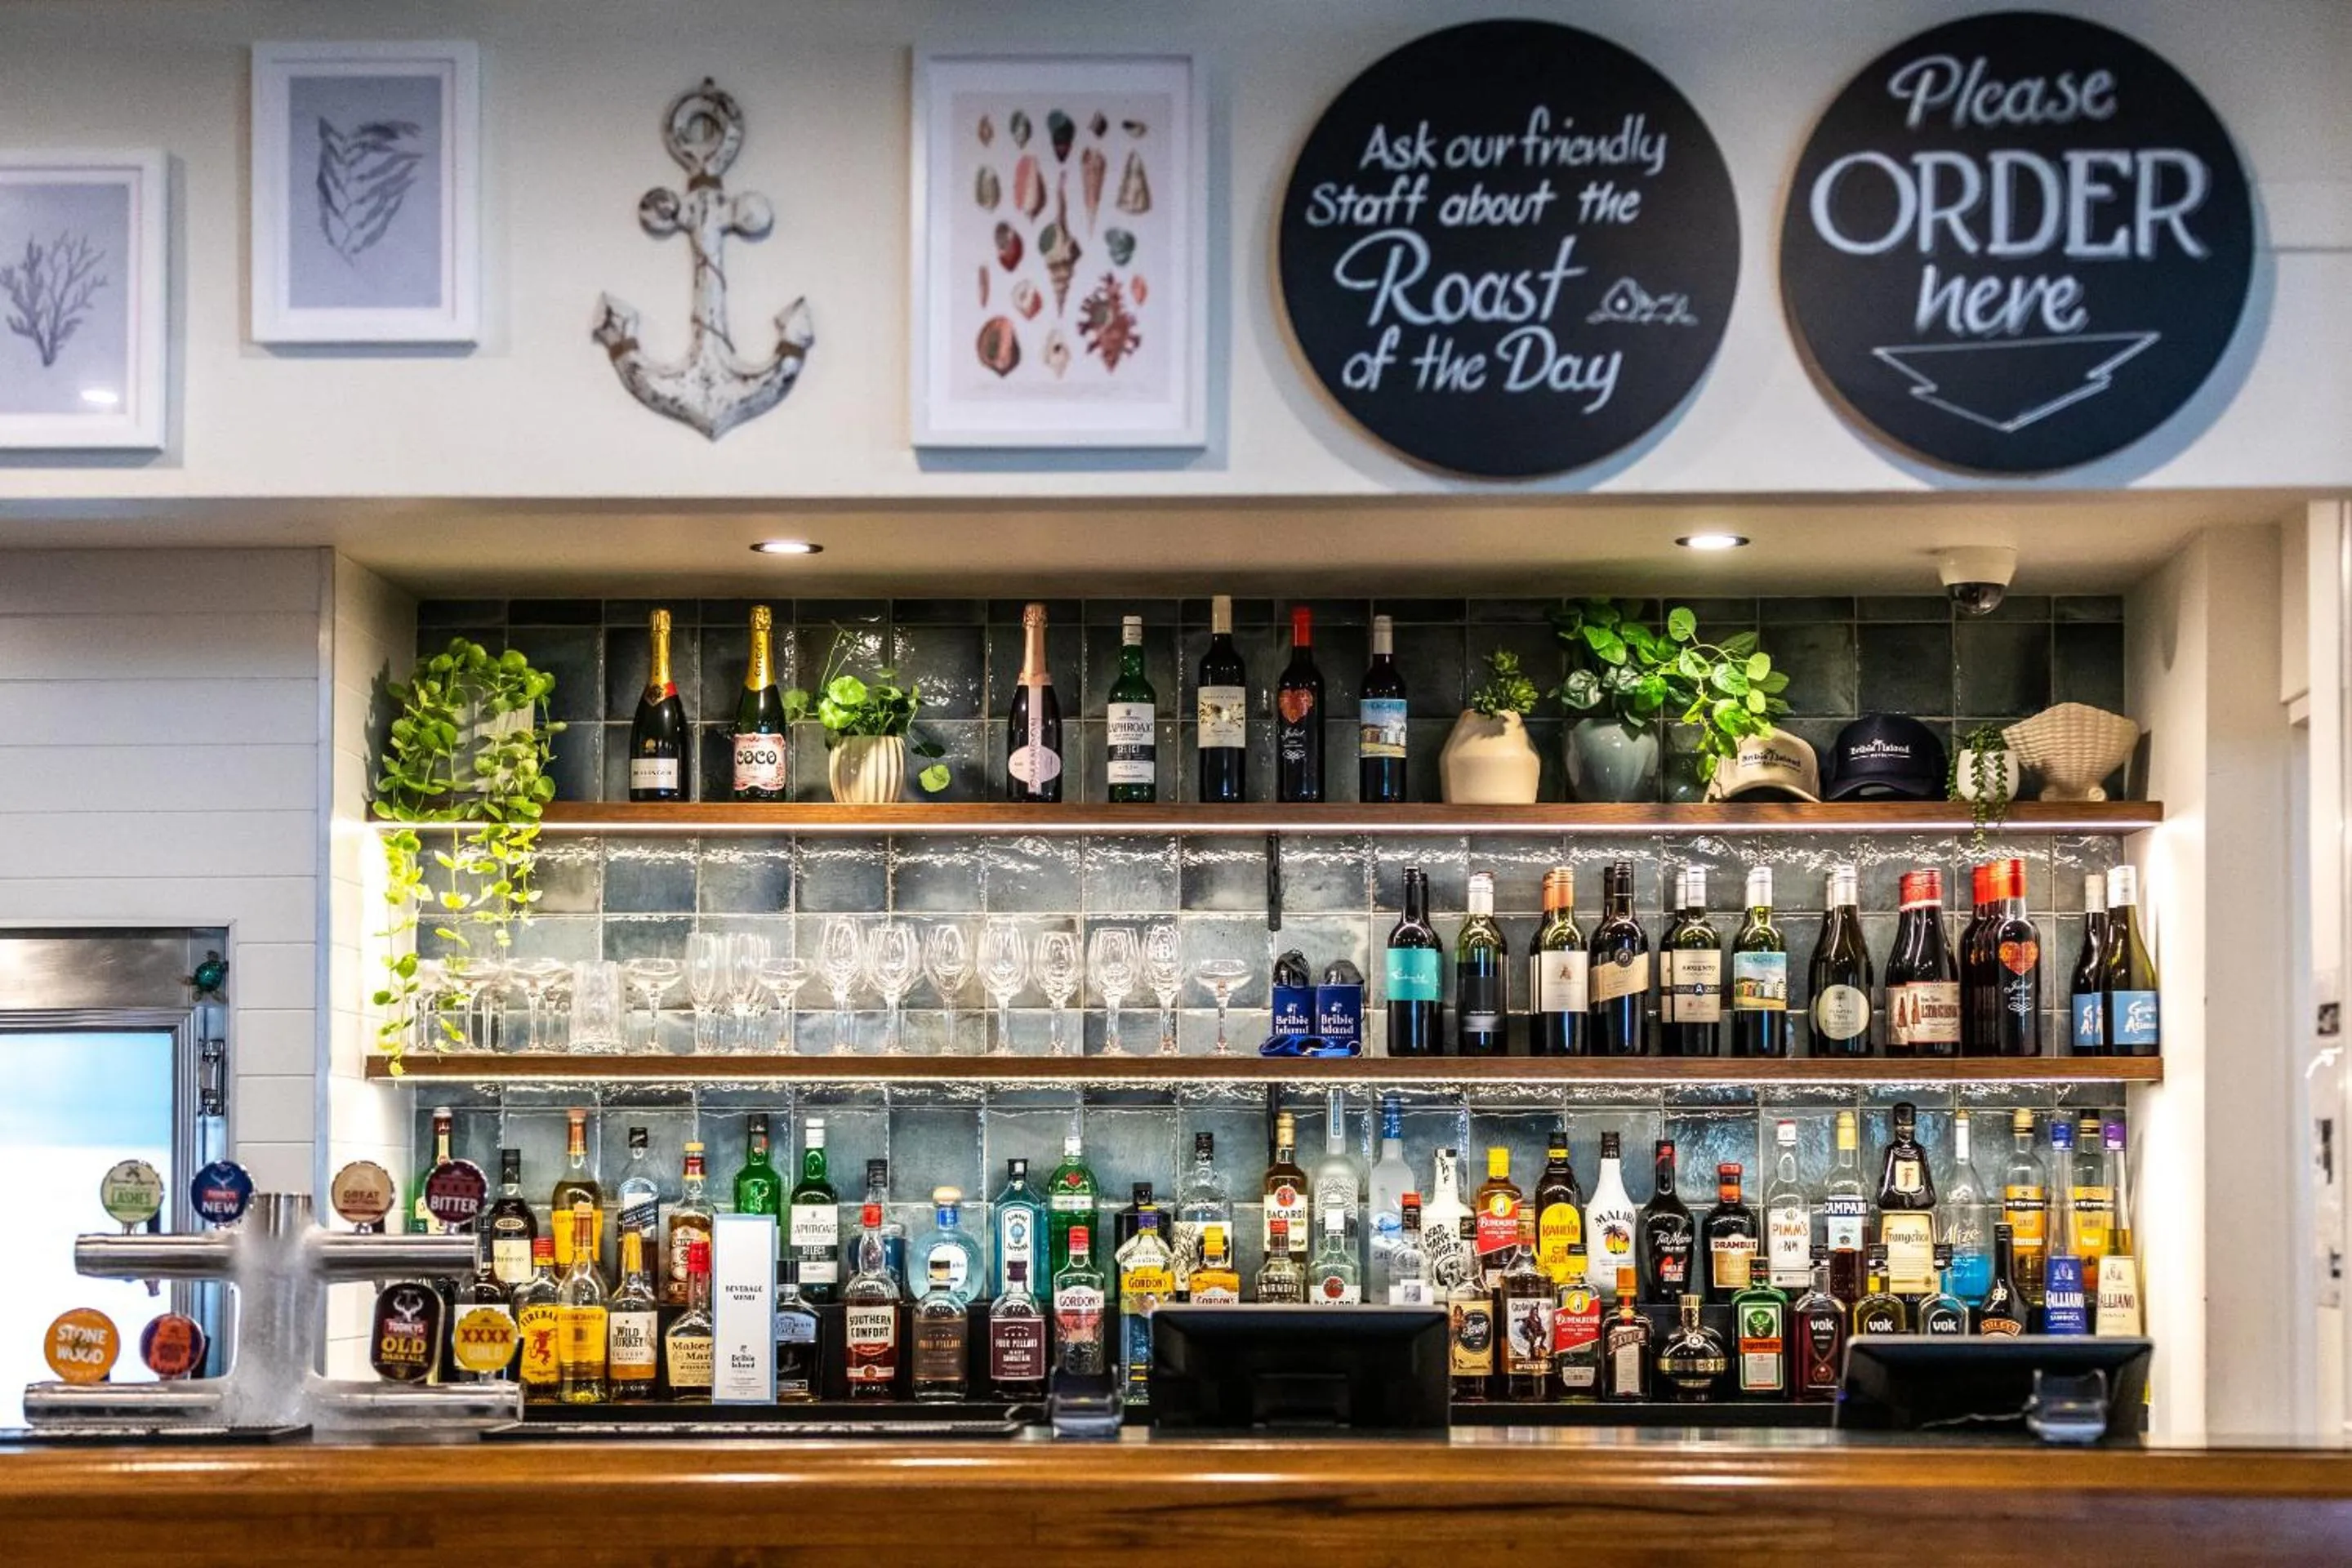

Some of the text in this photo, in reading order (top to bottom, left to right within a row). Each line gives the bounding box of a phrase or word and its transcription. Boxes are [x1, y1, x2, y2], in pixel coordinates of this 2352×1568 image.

[1888, 54, 2117, 129] Please
[1361, 105, 1668, 176] Ask our friendly
[1438, 184, 1555, 225] about
[1579, 181, 1640, 225] the
[1810, 150, 2212, 259] ORDER
[1335, 228, 1588, 328] Roast
[1916, 265, 2087, 336] here
[1342, 327, 1624, 416] of the Day
[736, 751, 777, 765] COCO
[1321, 1014, 1354, 1024] Bribie
[202, 1202, 238, 1214] NEW
[430, 1196, 478, 1213] BITTER
[849, 1315, 892, 1327] SOUTHERN
[56, 1325, 107, 1343] STONE
[461, 1329, 510, 1343] XXXX
[616, 1325, 639, 1337] WILD
[851, 1327, 889, 1338] COMFORT
[381, 1339, 426, 1353] OLD
[672, 1341, 712, 1351] Maker
[56, 1348, 105, 1365] WOOD
